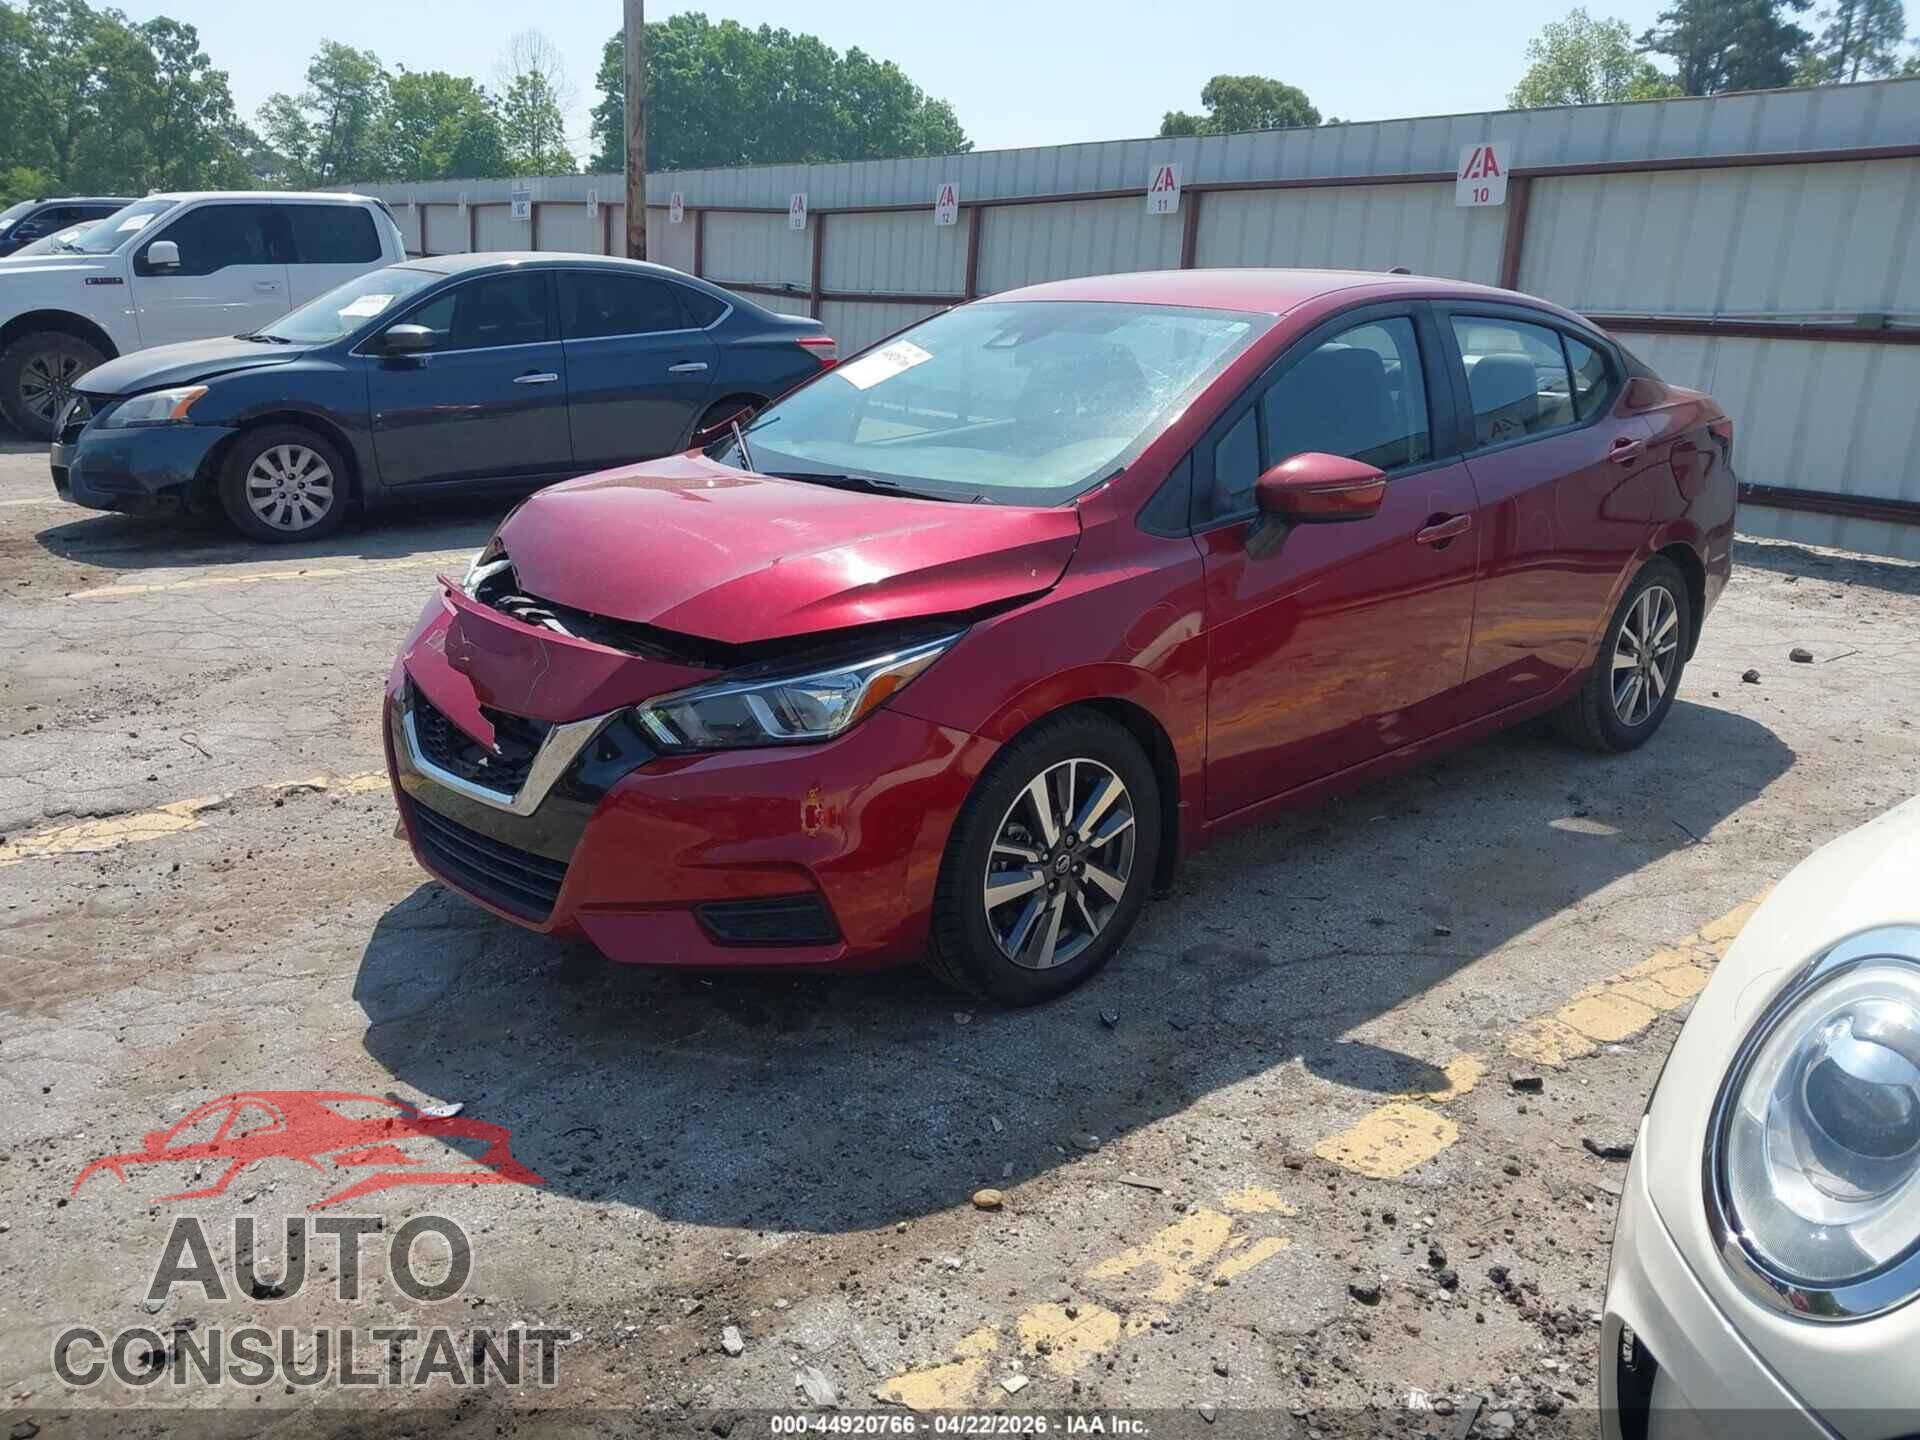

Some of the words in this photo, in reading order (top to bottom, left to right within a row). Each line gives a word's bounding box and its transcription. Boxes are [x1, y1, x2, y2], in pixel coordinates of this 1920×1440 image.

[1472, 187, 1489, 202] 10
[1157, 199, 1168, 211] 11
[942, 213, 950, 223] 12
